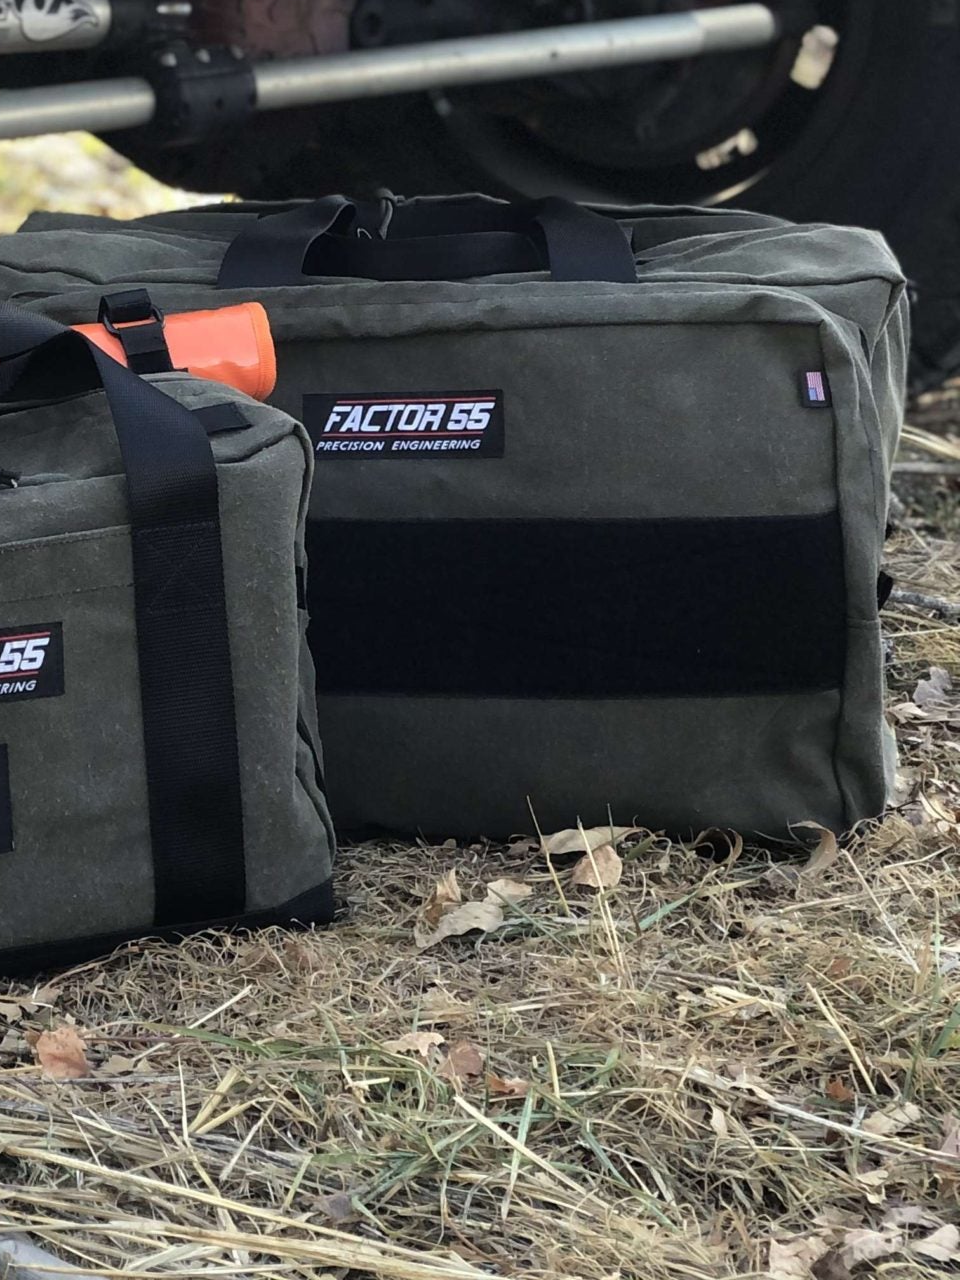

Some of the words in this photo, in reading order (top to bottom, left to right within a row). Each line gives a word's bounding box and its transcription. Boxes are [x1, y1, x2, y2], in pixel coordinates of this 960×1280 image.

[323, 403, 446, 432] FACTOR
[447, 402, 495, 431] 55
[316, 440, 385, 451] PRECISION
[391, 439, 481, 451] ENGINEERING
